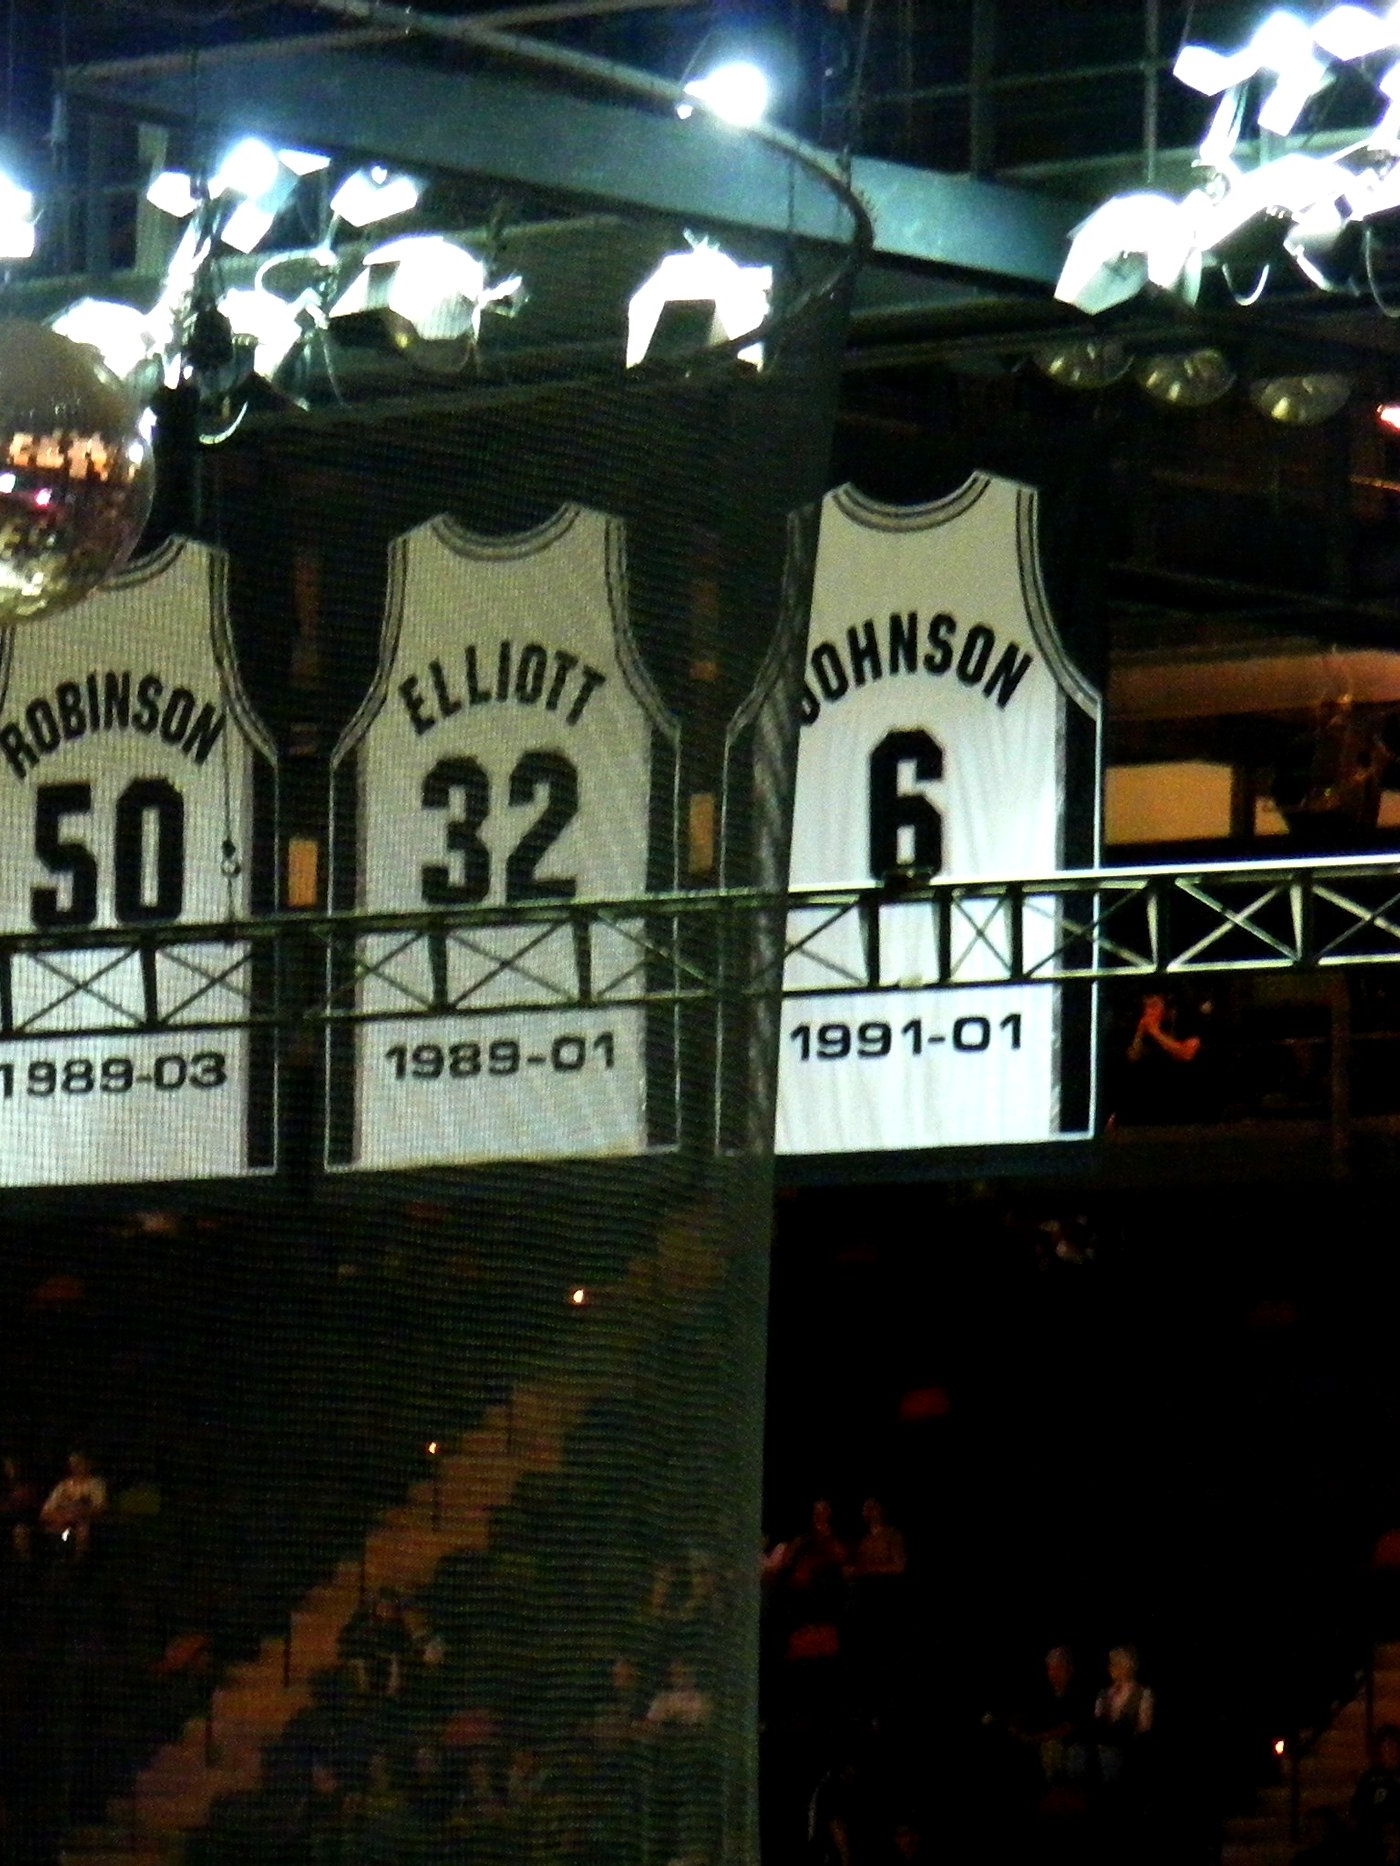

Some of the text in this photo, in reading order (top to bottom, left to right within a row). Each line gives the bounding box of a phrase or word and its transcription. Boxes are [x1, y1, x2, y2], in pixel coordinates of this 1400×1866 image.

[399, 640, 607, 737] ELLIOTT
[30, 777, 186, 930] 50
[421, 748, 579, 904] 32
[869, 724, 944, 882] 6
[384, 1031, 616, 1081] 1989-01
[790, 1012, 1023, 1062] 1991-01
